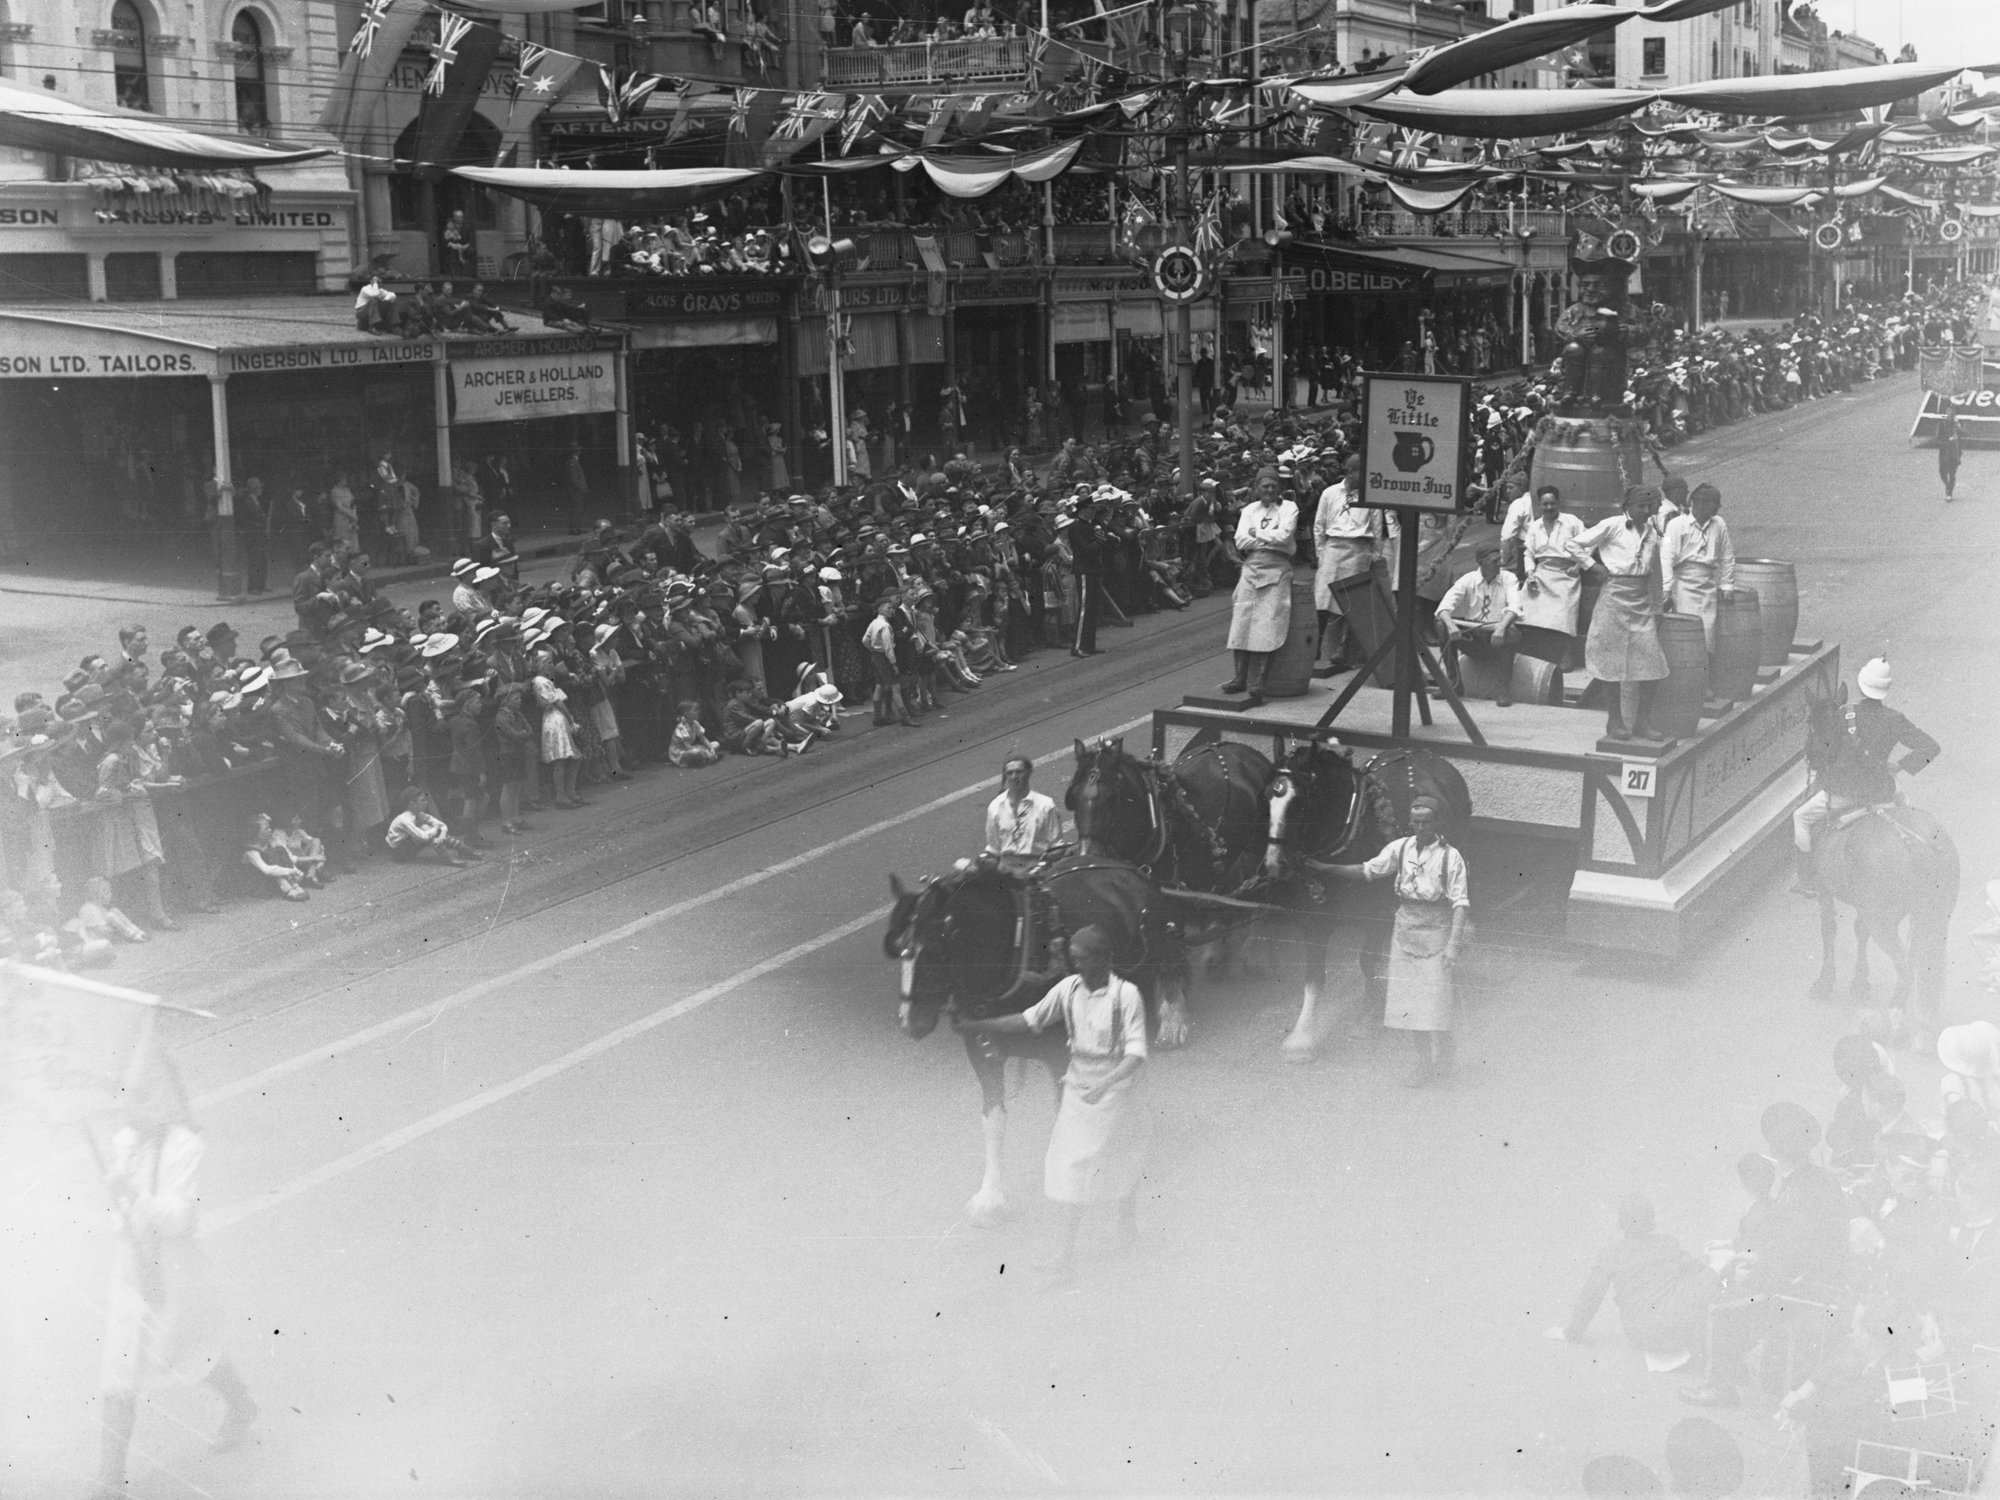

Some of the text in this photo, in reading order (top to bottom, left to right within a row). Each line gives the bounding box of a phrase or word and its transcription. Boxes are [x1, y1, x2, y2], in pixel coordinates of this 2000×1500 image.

[551, 118, 705, 134] AFTERNON
[683, 293, 741, 312] GRAYS
[474, 340, 528, 357] ARCHER
[539, 336, 594, 354] HOLLAND
[50, 354, 91, 374] LTD.
[98, 353, 197, 373] TAILORS.
[230, 350, 322, 371] INGERSON
[330, 348, 363, 366] LTD.
[370, 344, 434, 363] TAILORS
[464, 365, 604, 389] ARCHER & HOLLAND
[495, 386, 580, 406] JEWELLERS.
[1404, 388, 1425, 411] Ye
[1387, 408, 1439, 427] Little
[1369, 472, 1452, 499] Brown Jug
